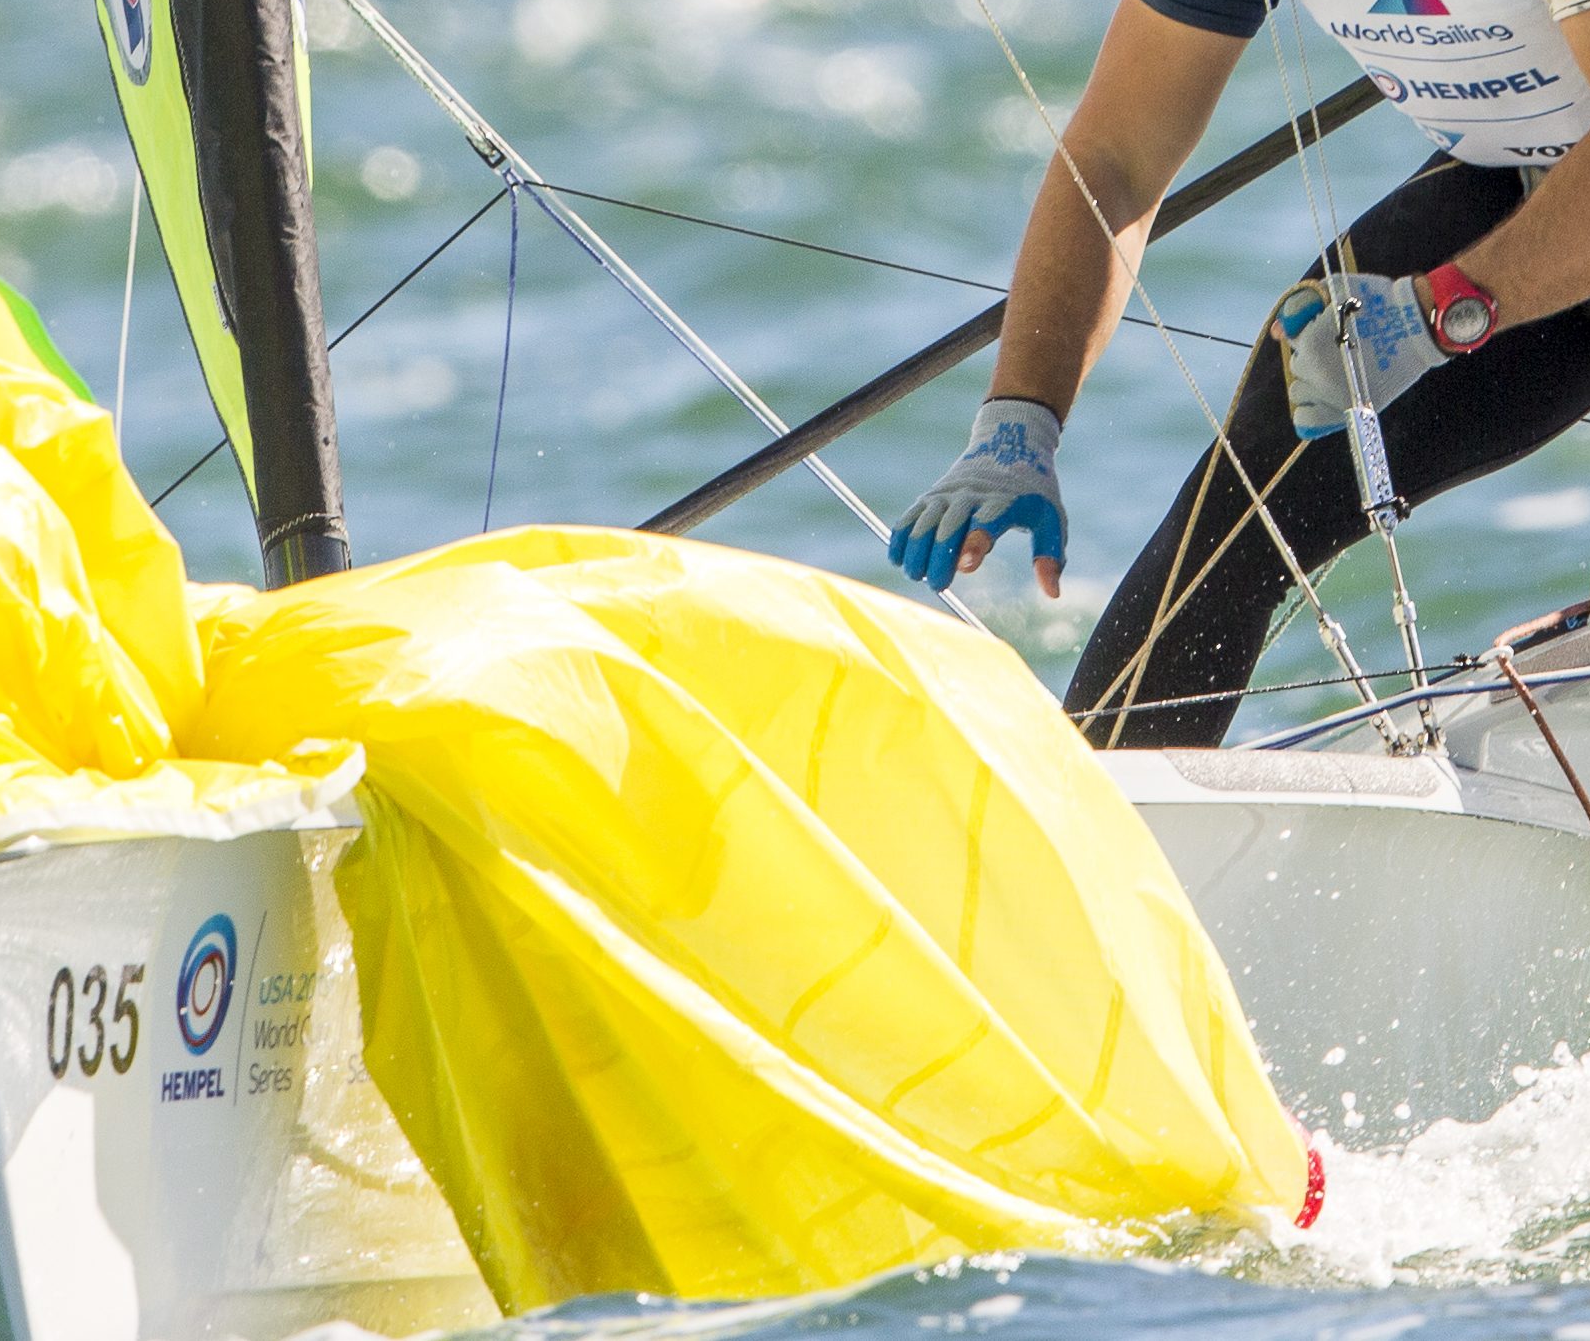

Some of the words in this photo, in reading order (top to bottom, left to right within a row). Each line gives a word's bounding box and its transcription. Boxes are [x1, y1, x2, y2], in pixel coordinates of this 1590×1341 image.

[1330, 21, 1411, 45] World
[1415, 22, 1515, 46] Sailing
[1409, 67, 1561, 100] HEMPEL
[258, 973, 294, 1005] USA
[47, 964, 146, 1080] 035
[254, 1014, 300, 1050] World
[162, 1067, 226, 1104] HEMPEL
[248, 1061, 293, 1096] Series
